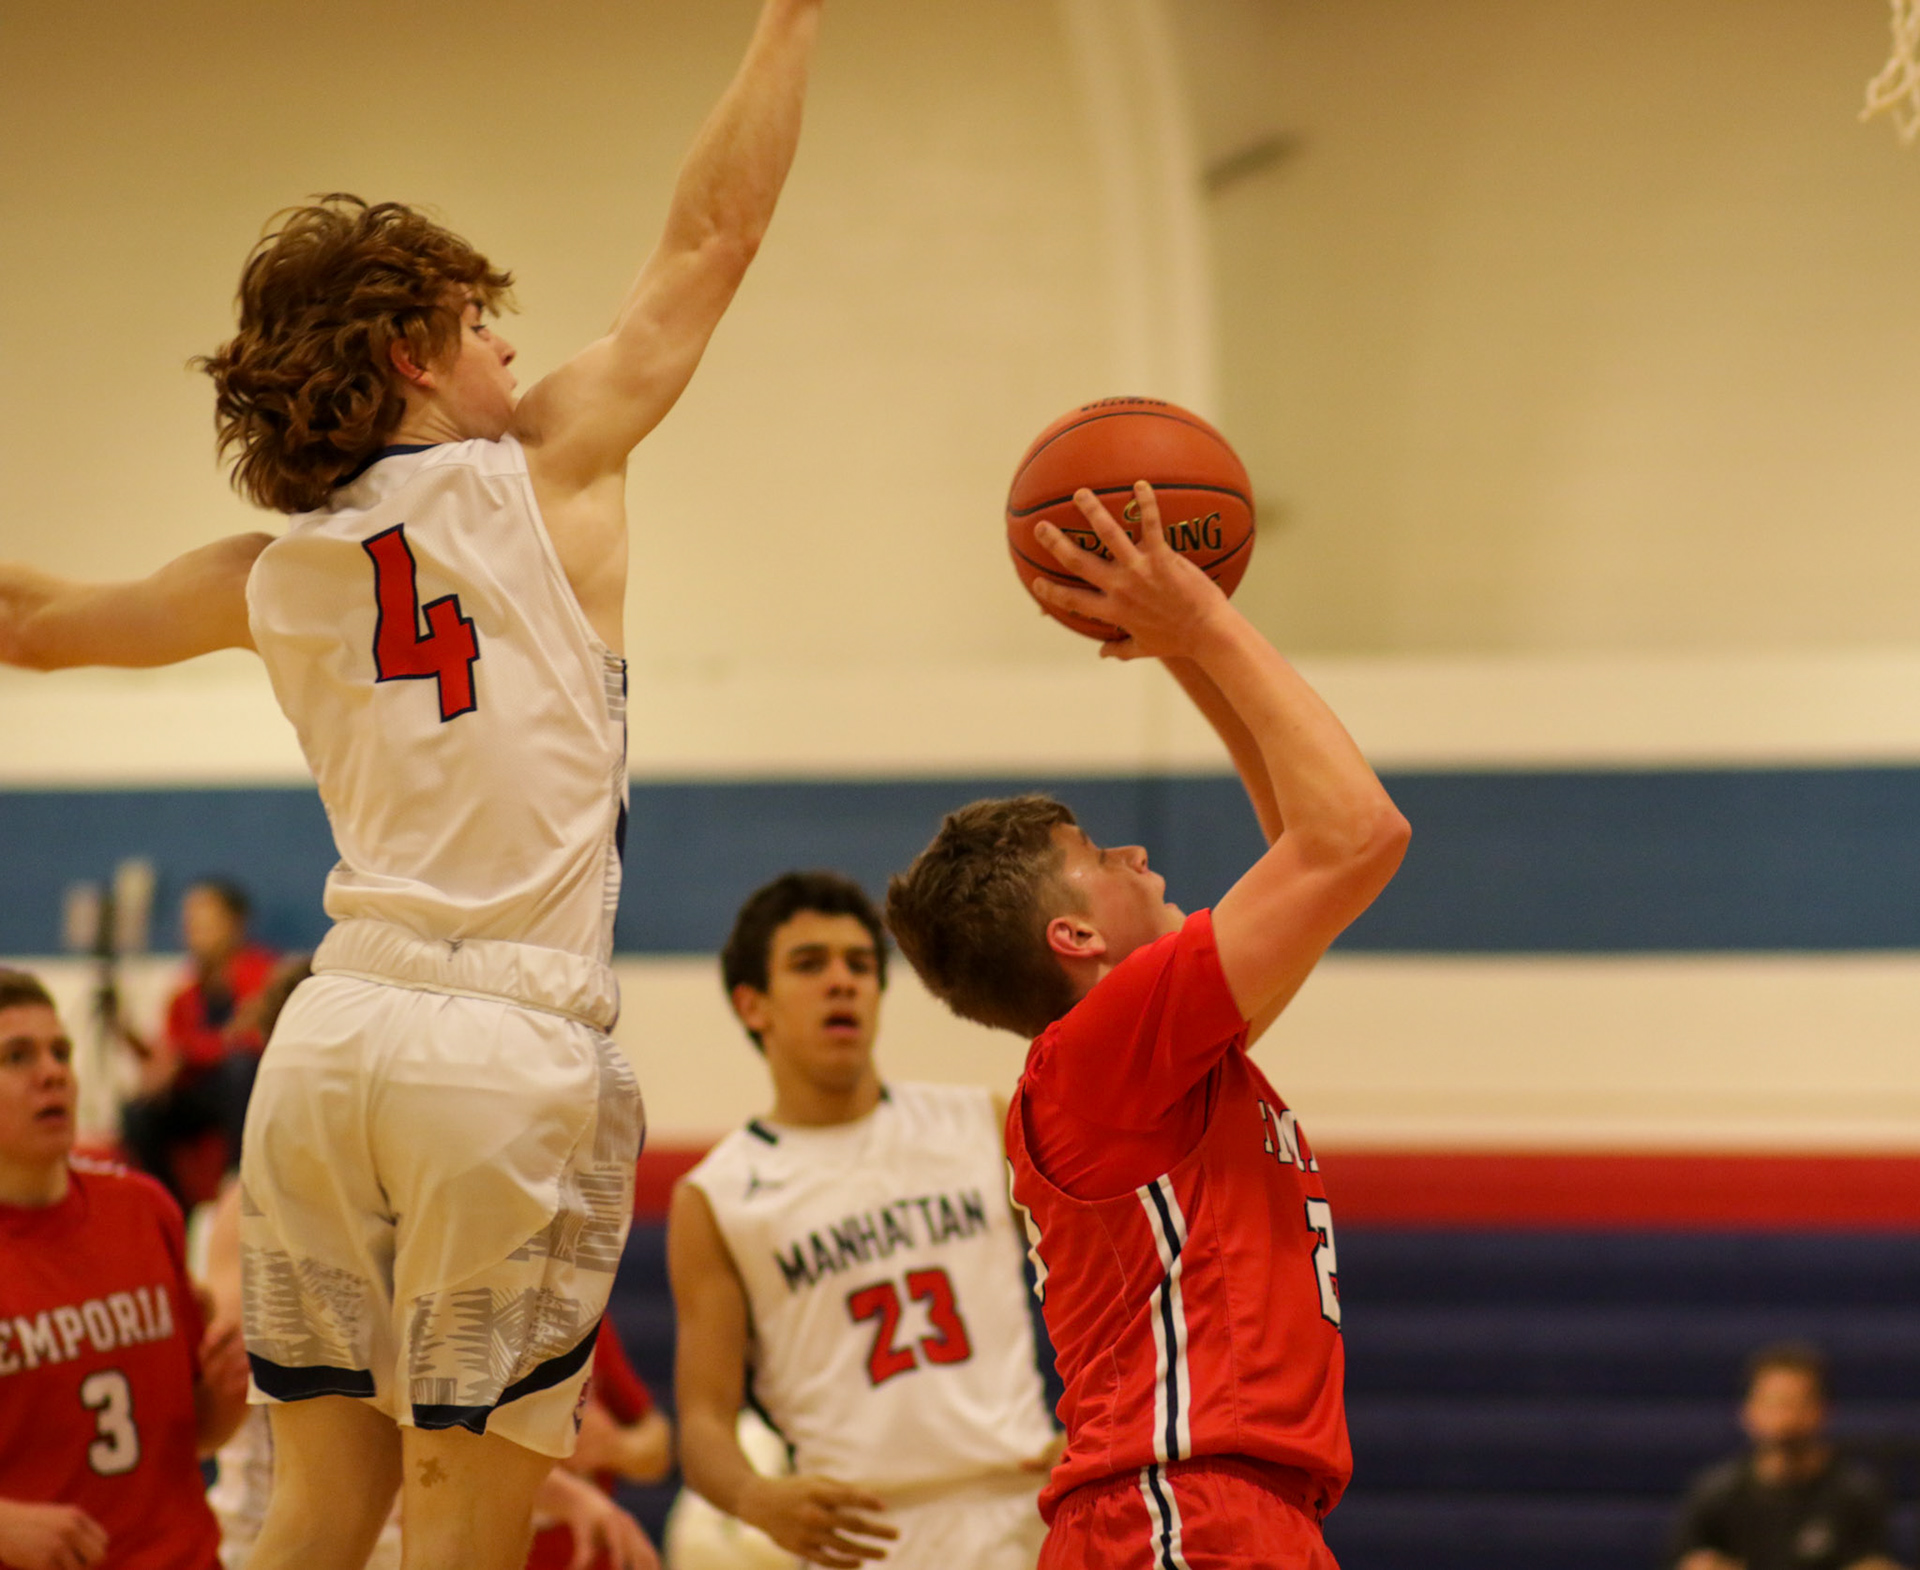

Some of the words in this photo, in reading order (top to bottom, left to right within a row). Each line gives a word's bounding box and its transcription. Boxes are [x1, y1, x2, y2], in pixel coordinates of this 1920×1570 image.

[361, 522, 480, 723] 4
[773, 1190, 987, 1292] MANHATTAN
[846, 1266, 973, 1388] 23
[82, 1369, 141, 1475] 3
